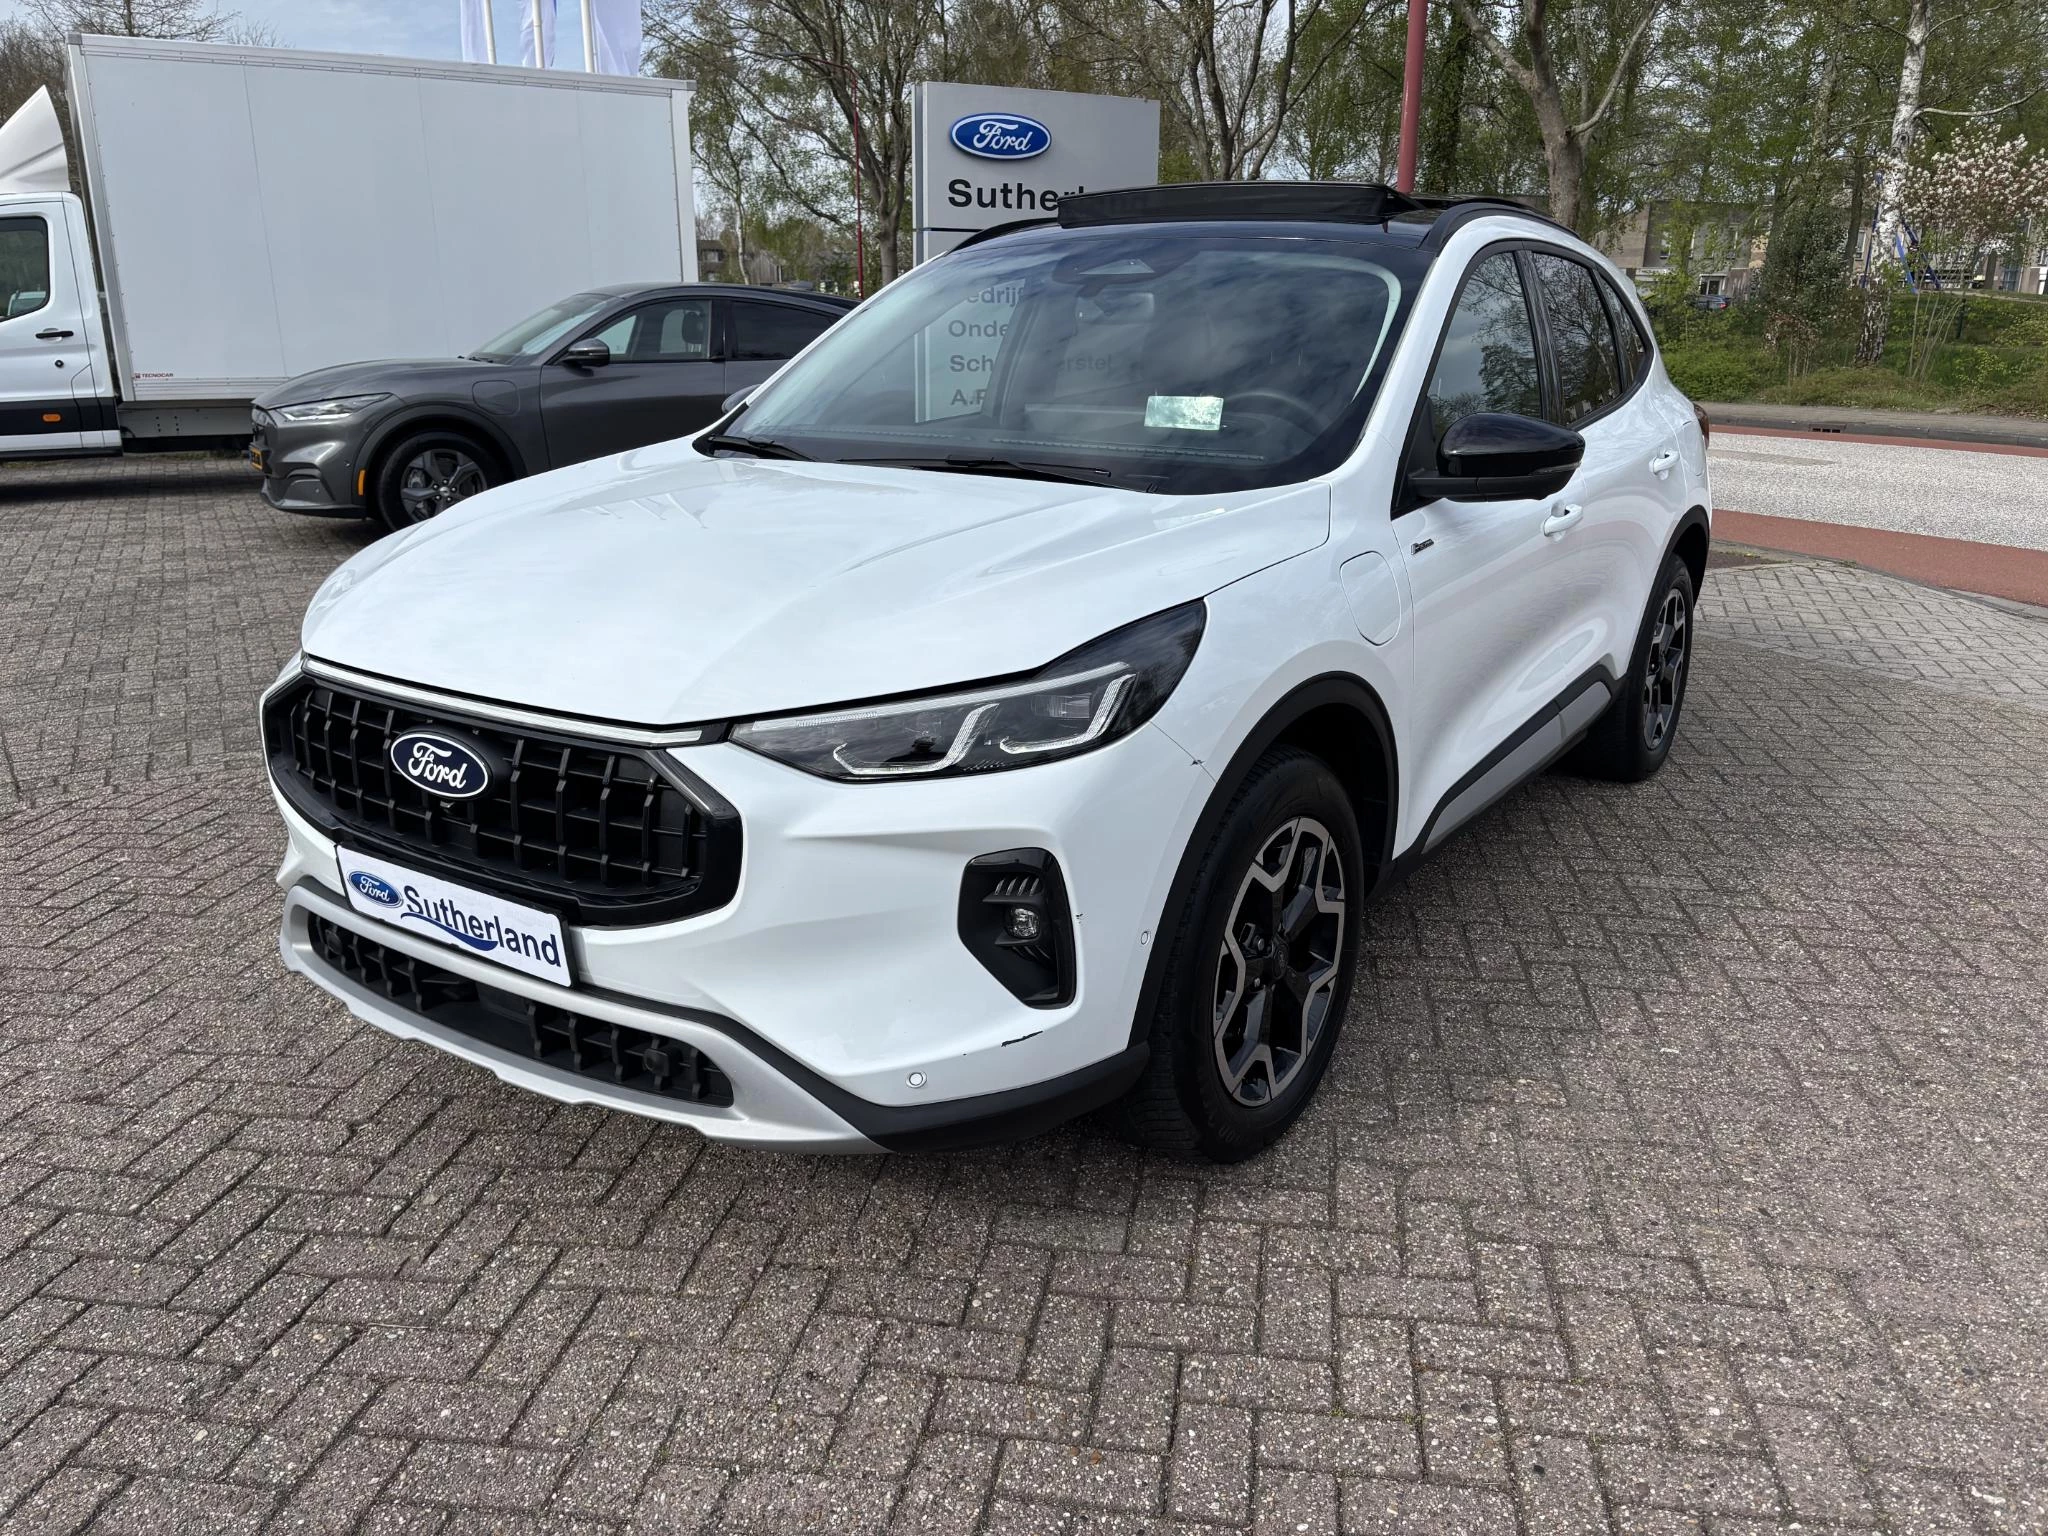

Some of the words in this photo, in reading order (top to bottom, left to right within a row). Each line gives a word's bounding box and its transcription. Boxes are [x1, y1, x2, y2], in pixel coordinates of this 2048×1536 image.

[973, 120, 1033, 151] Ford
[948, 178, 1084, 212] Suthe
[408, 741, 468, 789] Ford
[360, 875, 390, 902] Ford
[404, 885, 562, 968] Sutherland
